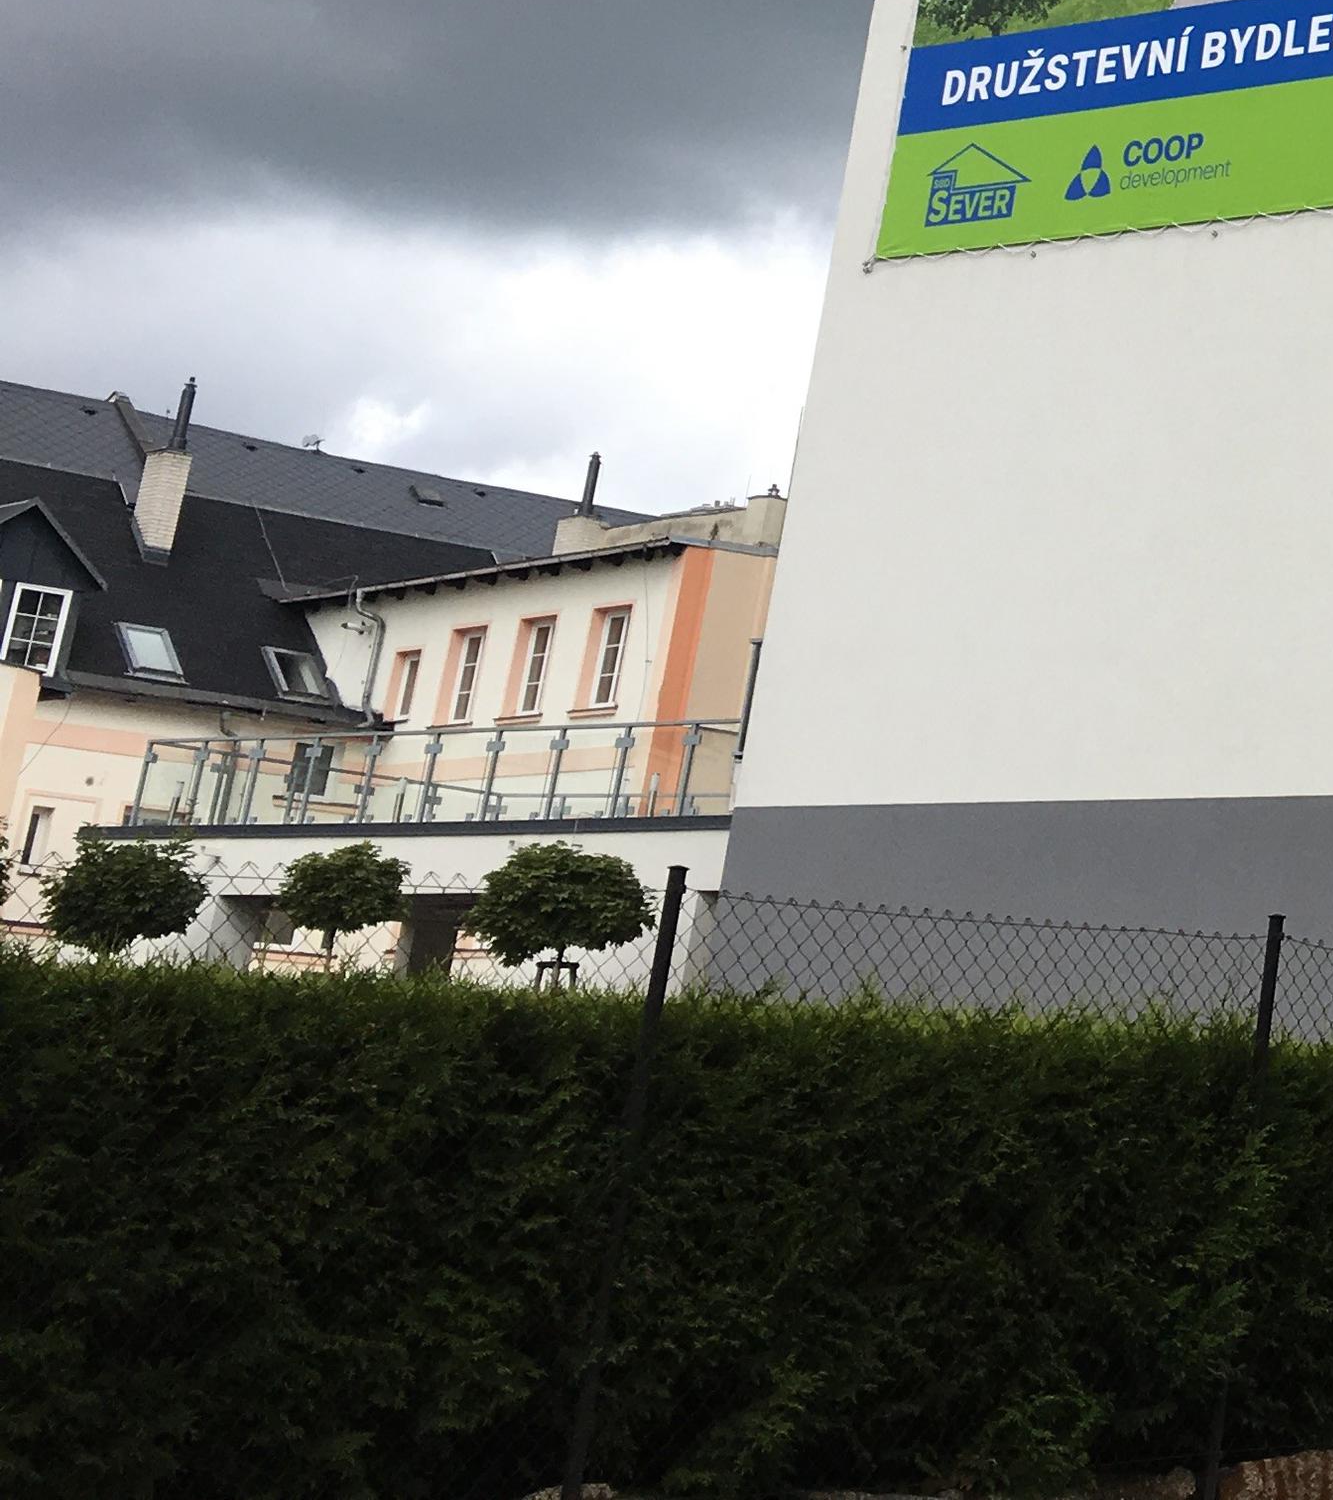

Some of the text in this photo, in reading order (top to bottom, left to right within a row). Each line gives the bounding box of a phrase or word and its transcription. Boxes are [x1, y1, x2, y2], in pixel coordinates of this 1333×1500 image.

[940, 25, 1195, 106] DRUŽSTEVNÍ
[1123, 132, 1204, 167] COOP
[1119, 159, 1232, 191] development
[928, 189, 1010, 224] SEVER
